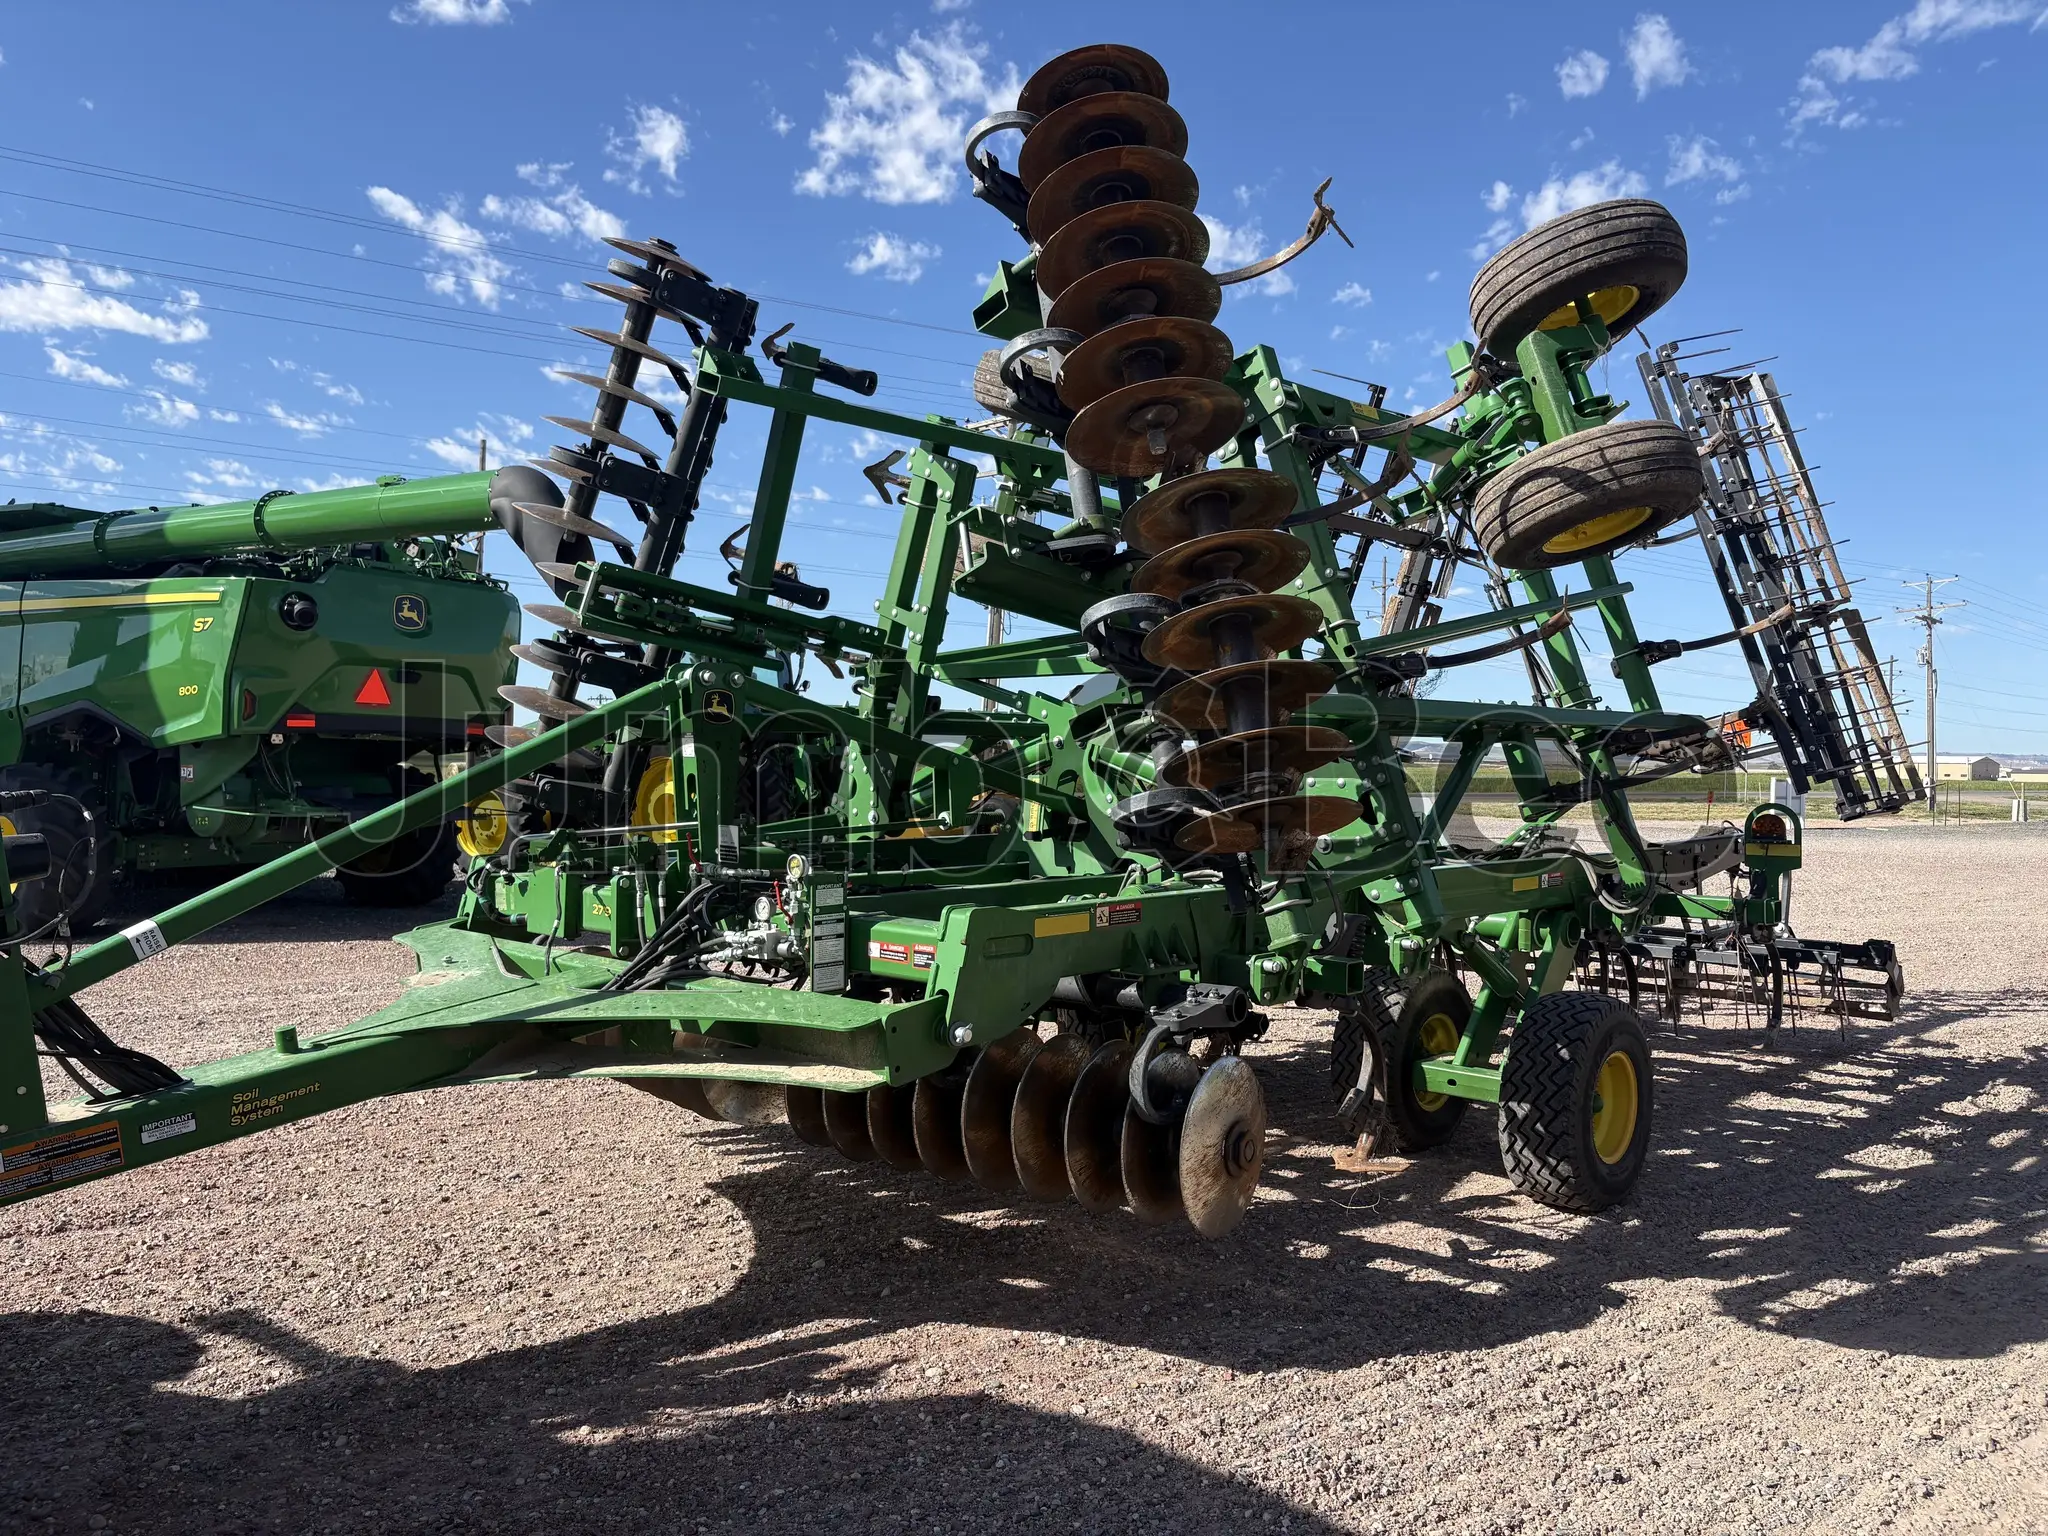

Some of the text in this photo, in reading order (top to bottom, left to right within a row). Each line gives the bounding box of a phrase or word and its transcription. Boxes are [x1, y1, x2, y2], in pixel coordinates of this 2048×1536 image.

[193, 617, 214, 632] S7
[178, 685, 198, 696] 800
[141, 931, 156, 953] FRONT
[148, 929, 162, 950] RAISE
[231, 1082, 320, 1115] Management
[232, 1087, 259, 1104] Soil
[142, 1112, 193, 1132] IMPORTANT
[230, 1104, 284, 1126] System
[40, 1132, 76, 1147] WARNING
[44, 1154, 79, 1168] WARNING
